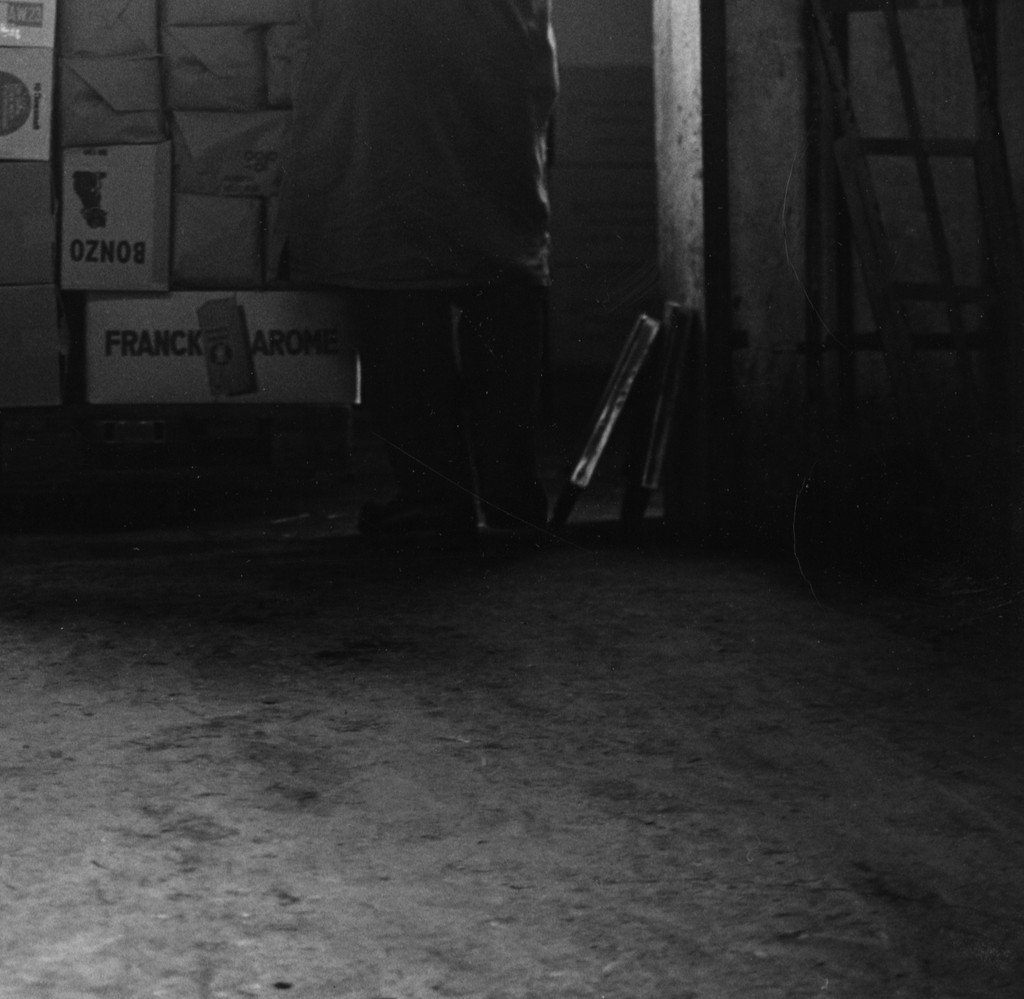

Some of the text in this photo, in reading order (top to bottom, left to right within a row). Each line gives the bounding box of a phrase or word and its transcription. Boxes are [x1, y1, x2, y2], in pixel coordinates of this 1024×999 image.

[69, 238, 146, 265] BONZO
[104, 329, 204, 357] FRANCK
[251, 329, 339, 357] AROME
